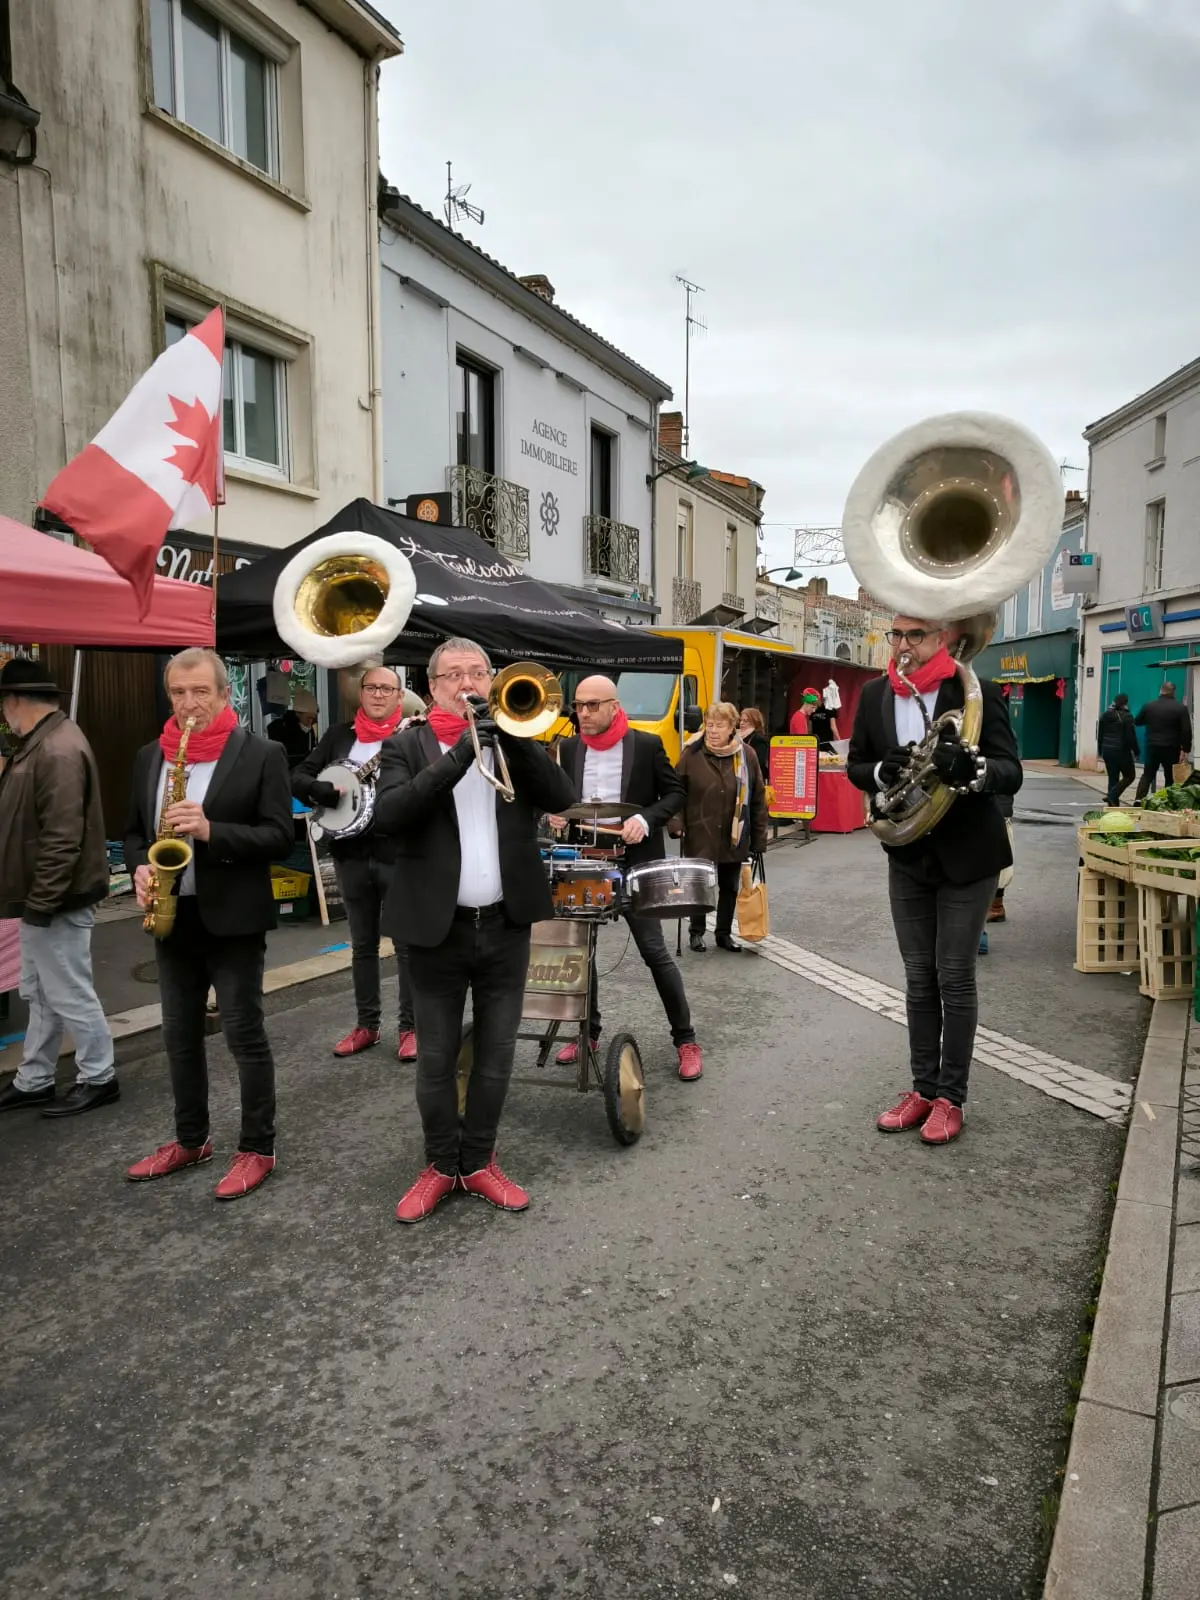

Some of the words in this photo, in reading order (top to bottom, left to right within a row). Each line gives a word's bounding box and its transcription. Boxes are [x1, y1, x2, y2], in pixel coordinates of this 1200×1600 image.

[532, 419, 567, 448] AGENCE
[521, 439, 578, 476] IMMOBILIERE
[156, 545, 224, 584] Nat
[435, 552, 524, 578] Toulvern
[1131, 611, 1150, 628] CIC
